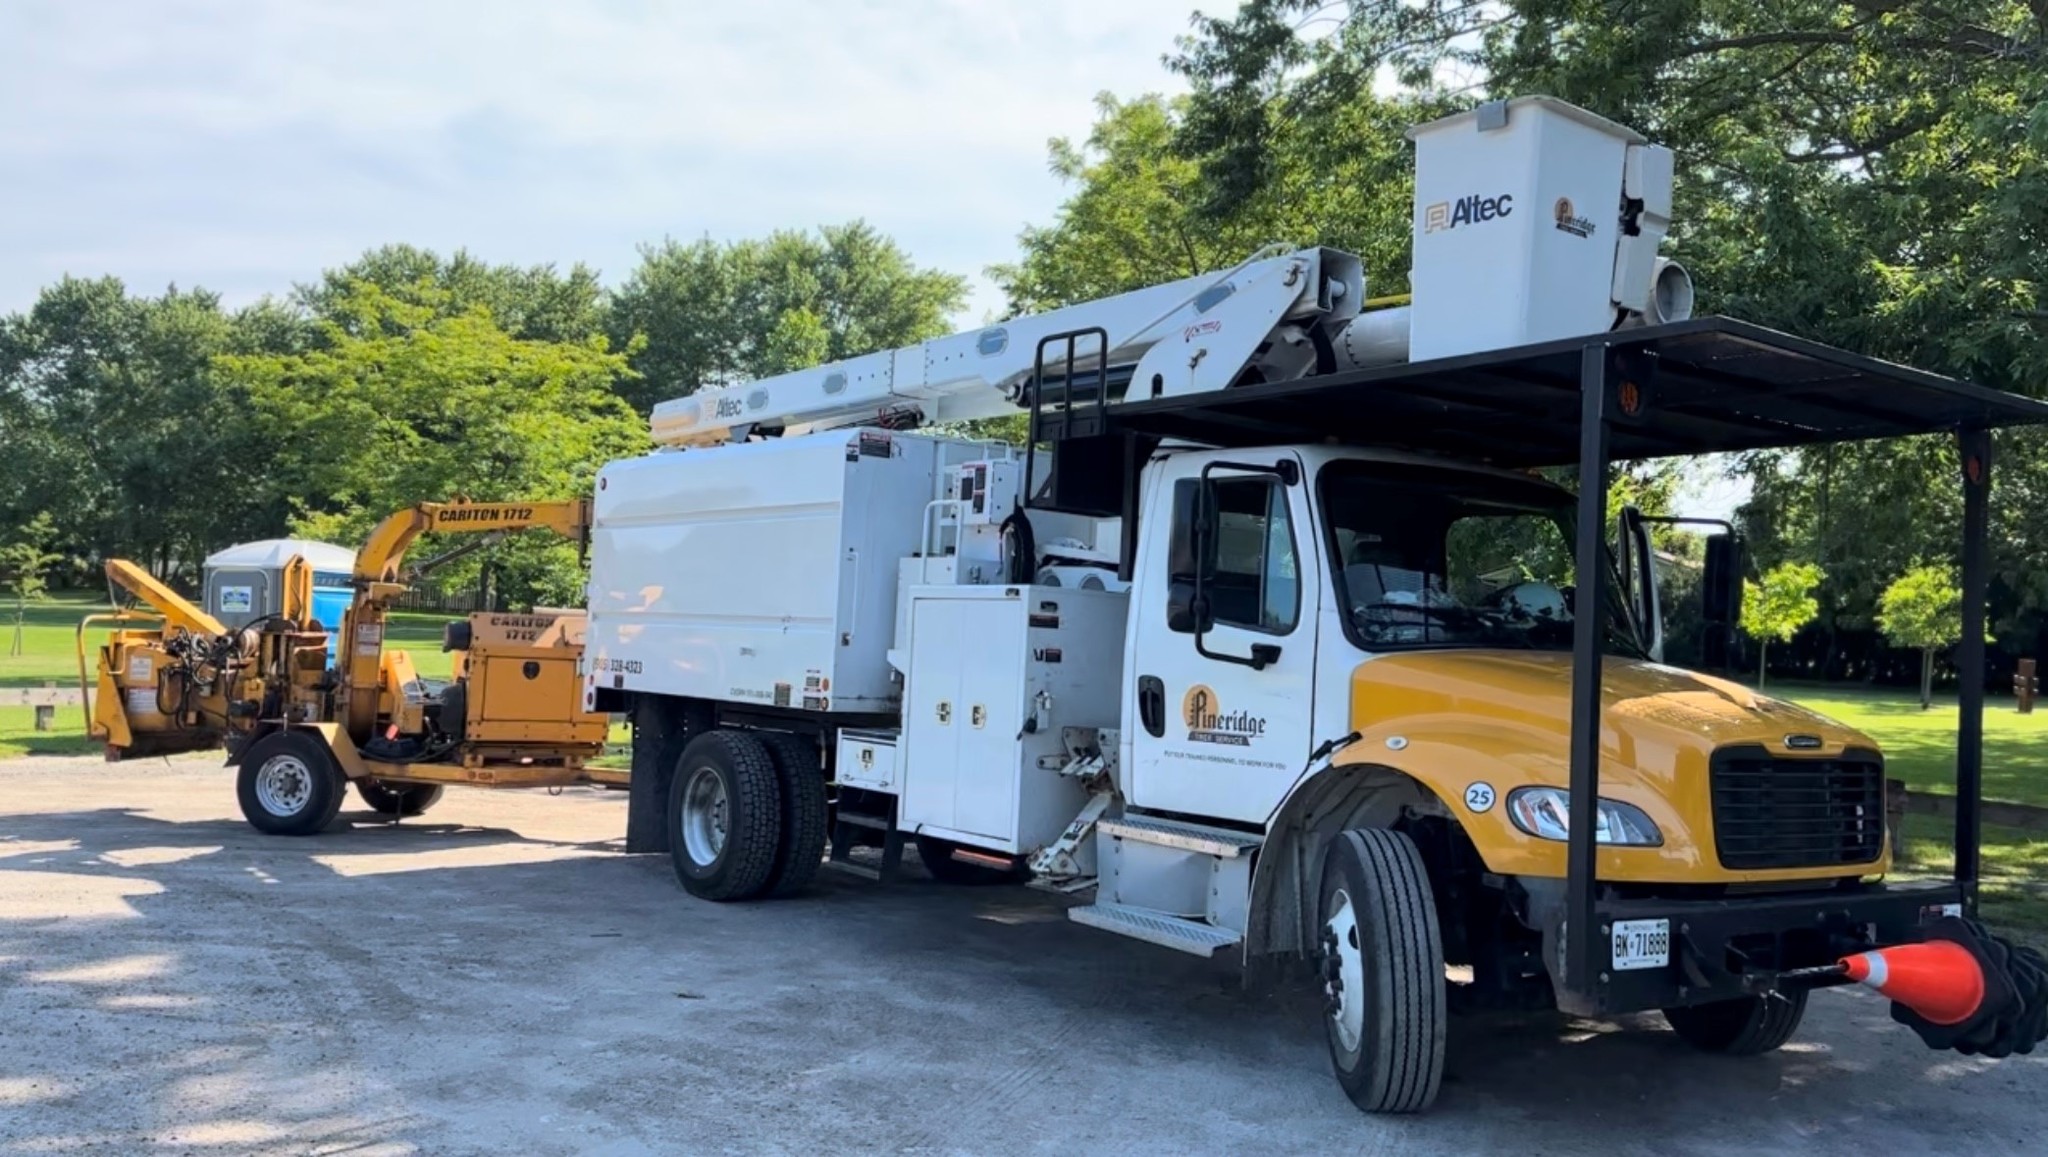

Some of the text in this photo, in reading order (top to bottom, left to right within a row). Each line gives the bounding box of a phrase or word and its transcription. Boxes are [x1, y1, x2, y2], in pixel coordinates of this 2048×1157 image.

[1450, 194, 1512, 229] Altec
[715, 397, 742, 419] Altec
[503, 508, 533, 520] 1712
[505, 629, 536, 642] 1712
[1189, 689, 1266, 738] Pineridge
[1469, 789, 1490, 805] 25
